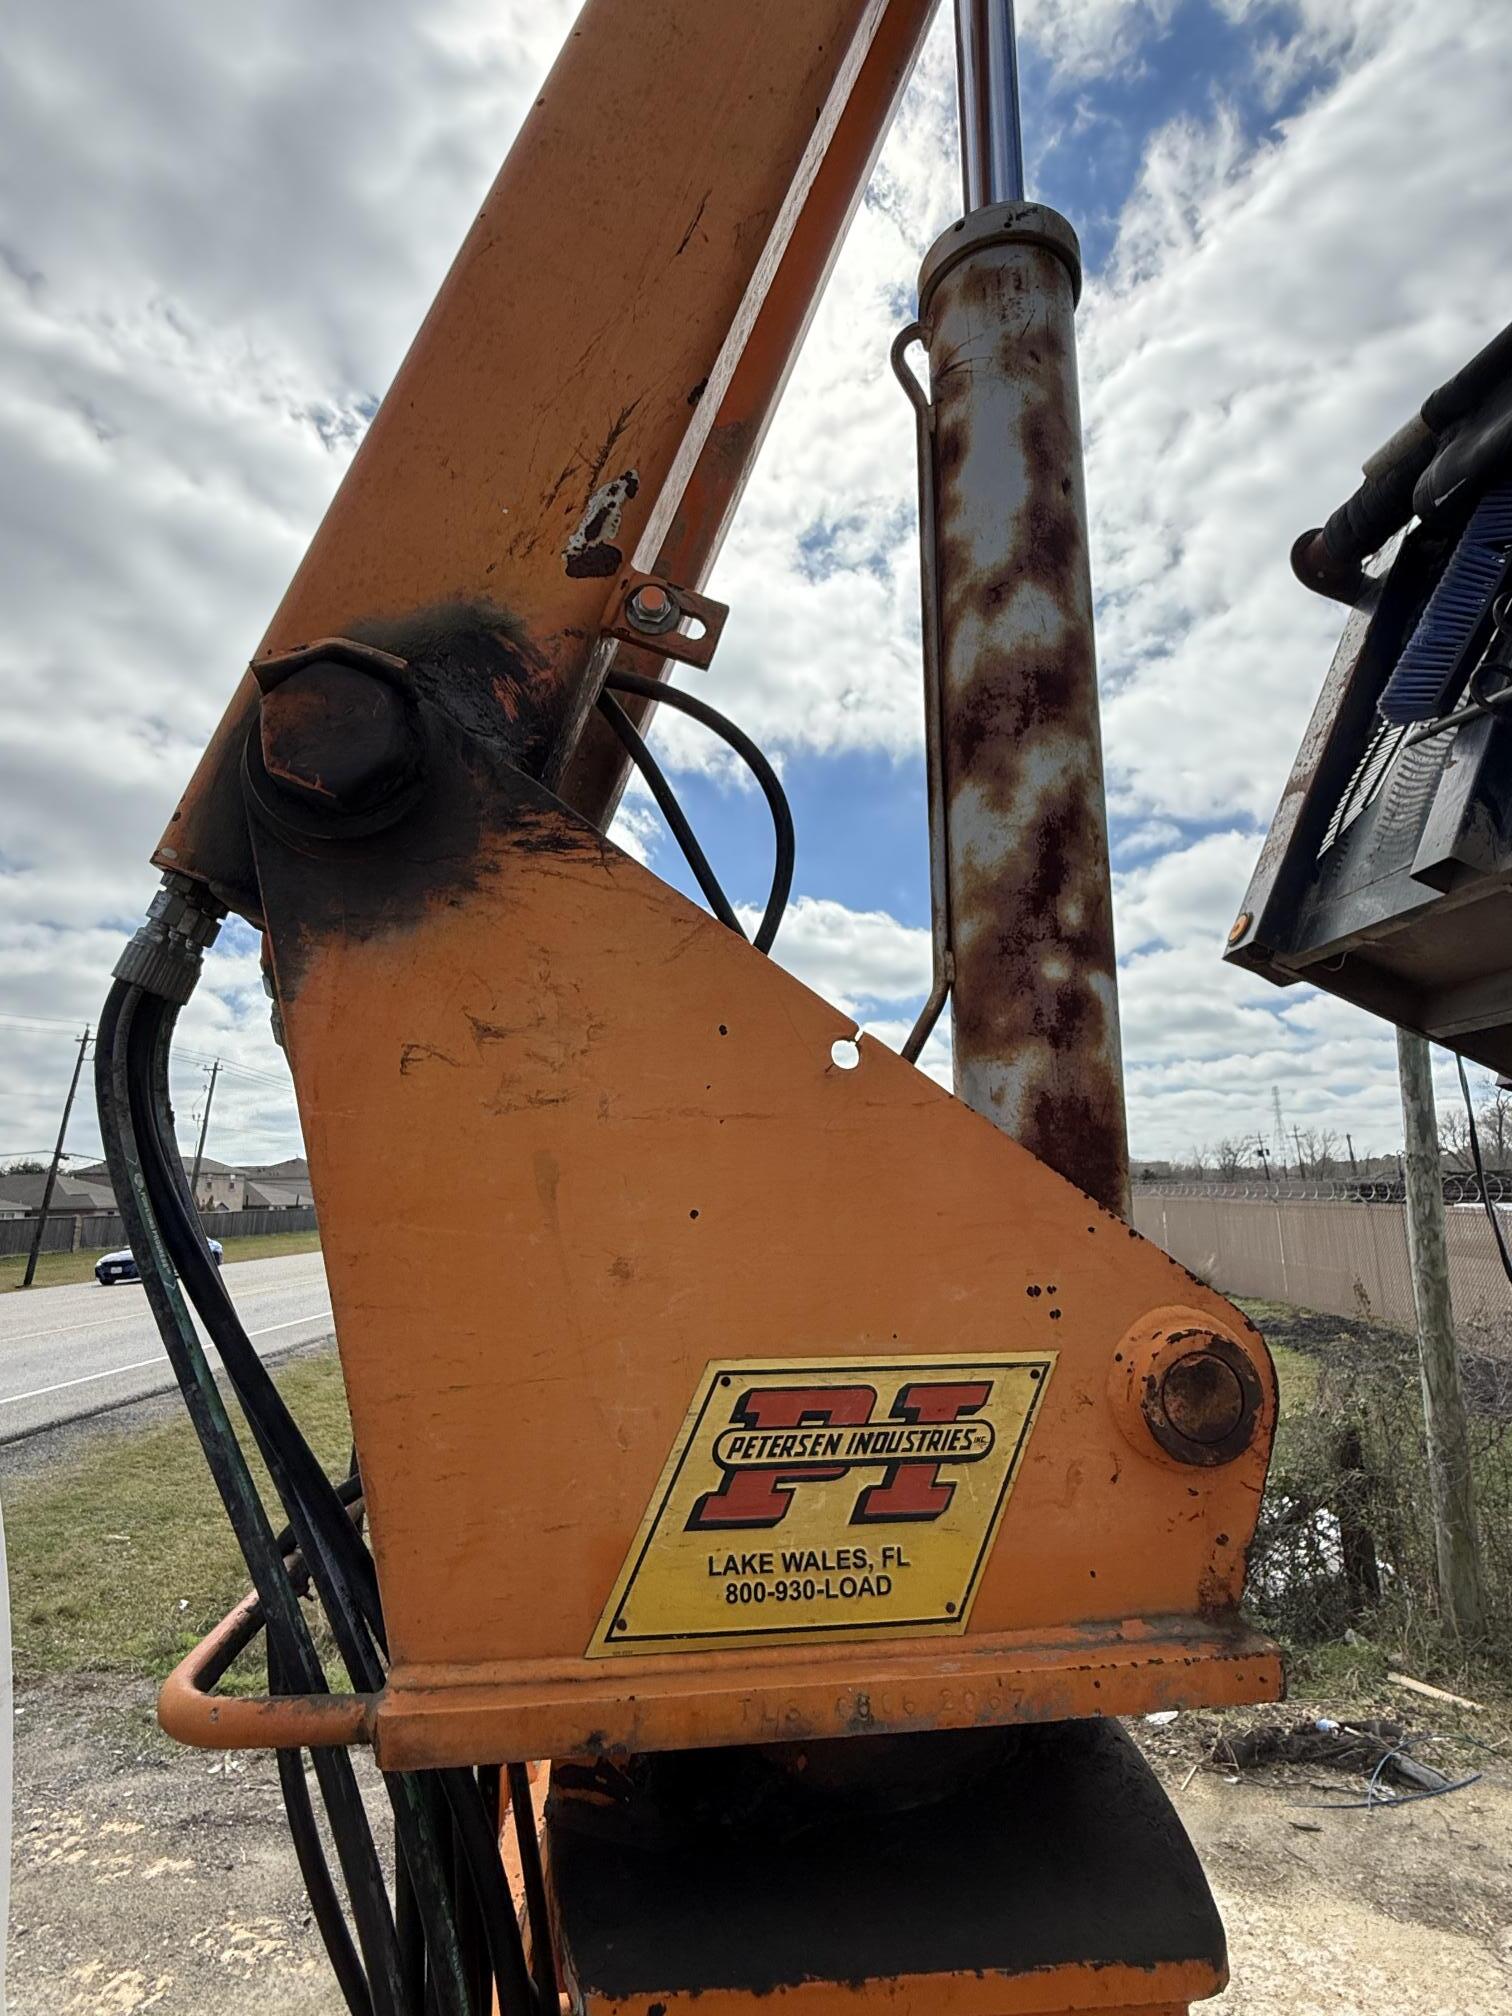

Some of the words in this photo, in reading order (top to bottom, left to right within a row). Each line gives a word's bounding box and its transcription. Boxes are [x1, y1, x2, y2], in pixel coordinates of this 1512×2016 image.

[726, 1433, 843, 1459] PETERSEN
[846, 1428, 976, 1456] INDUSTRIES
[708, 1553, 774, 1576] LAKE
[781, 1548, 874, 1573] WALES,
[881, 1547, 911, 1568] FL
[725, 1574, 893, 1604] 800-930-LOAD
